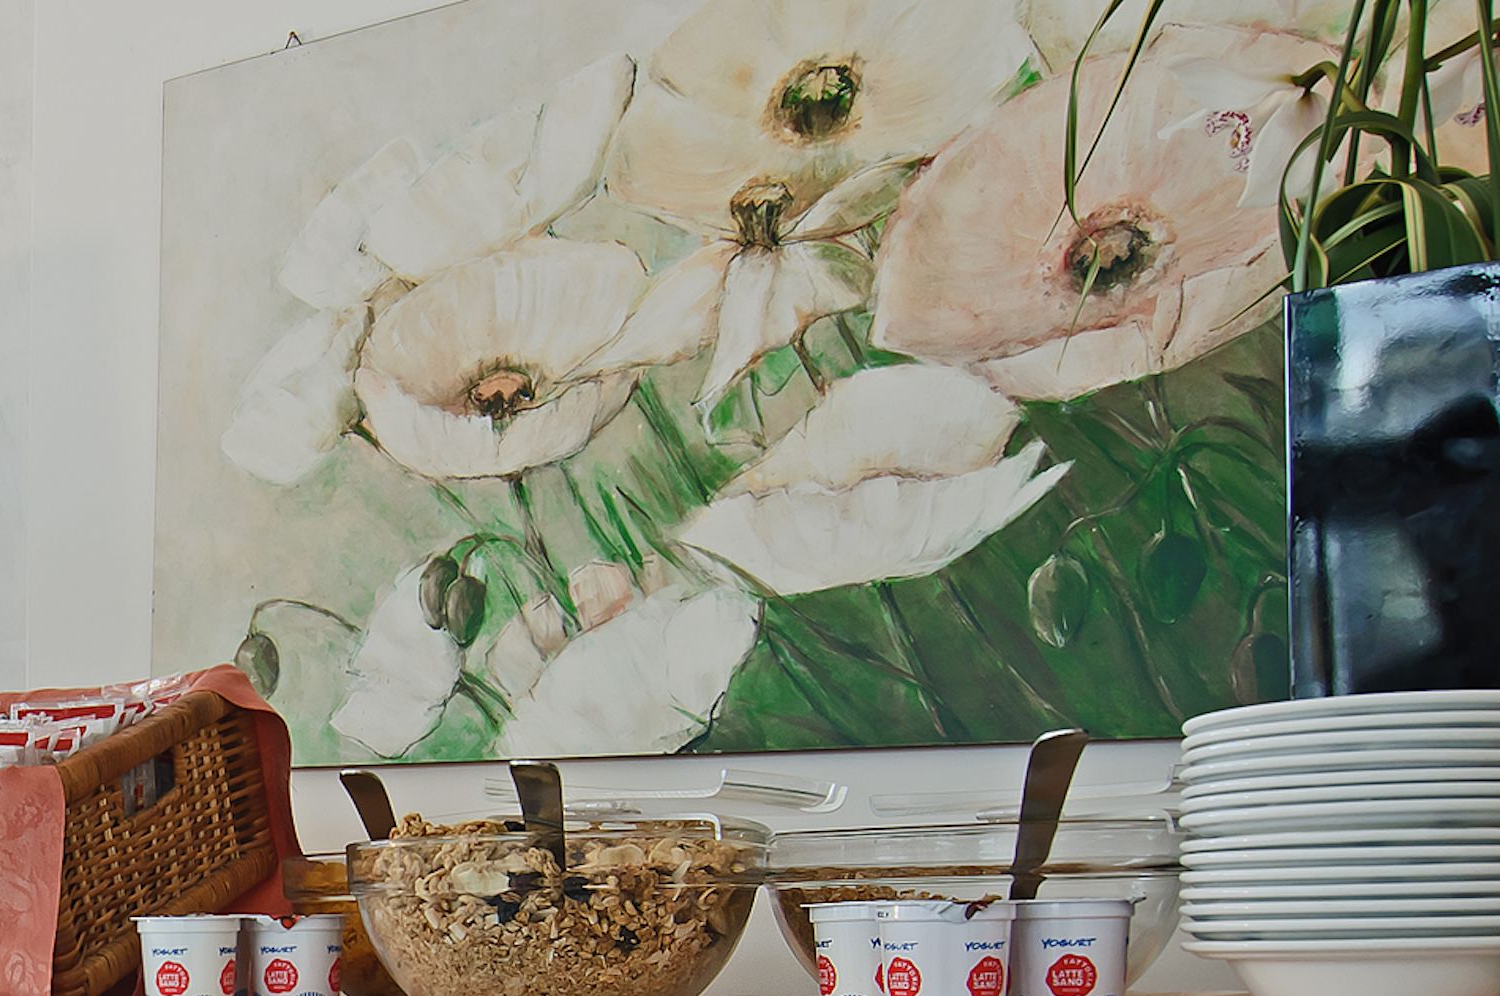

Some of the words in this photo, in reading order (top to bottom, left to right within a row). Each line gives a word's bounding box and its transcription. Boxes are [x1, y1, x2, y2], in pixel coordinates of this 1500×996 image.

[1042, 937, 1096, 949] YOGURT
[973, 972, 997, 981] LATTE
[1052, 969, 1083, 979] LATTE
[1052, 978, 1083, 987] SANO
